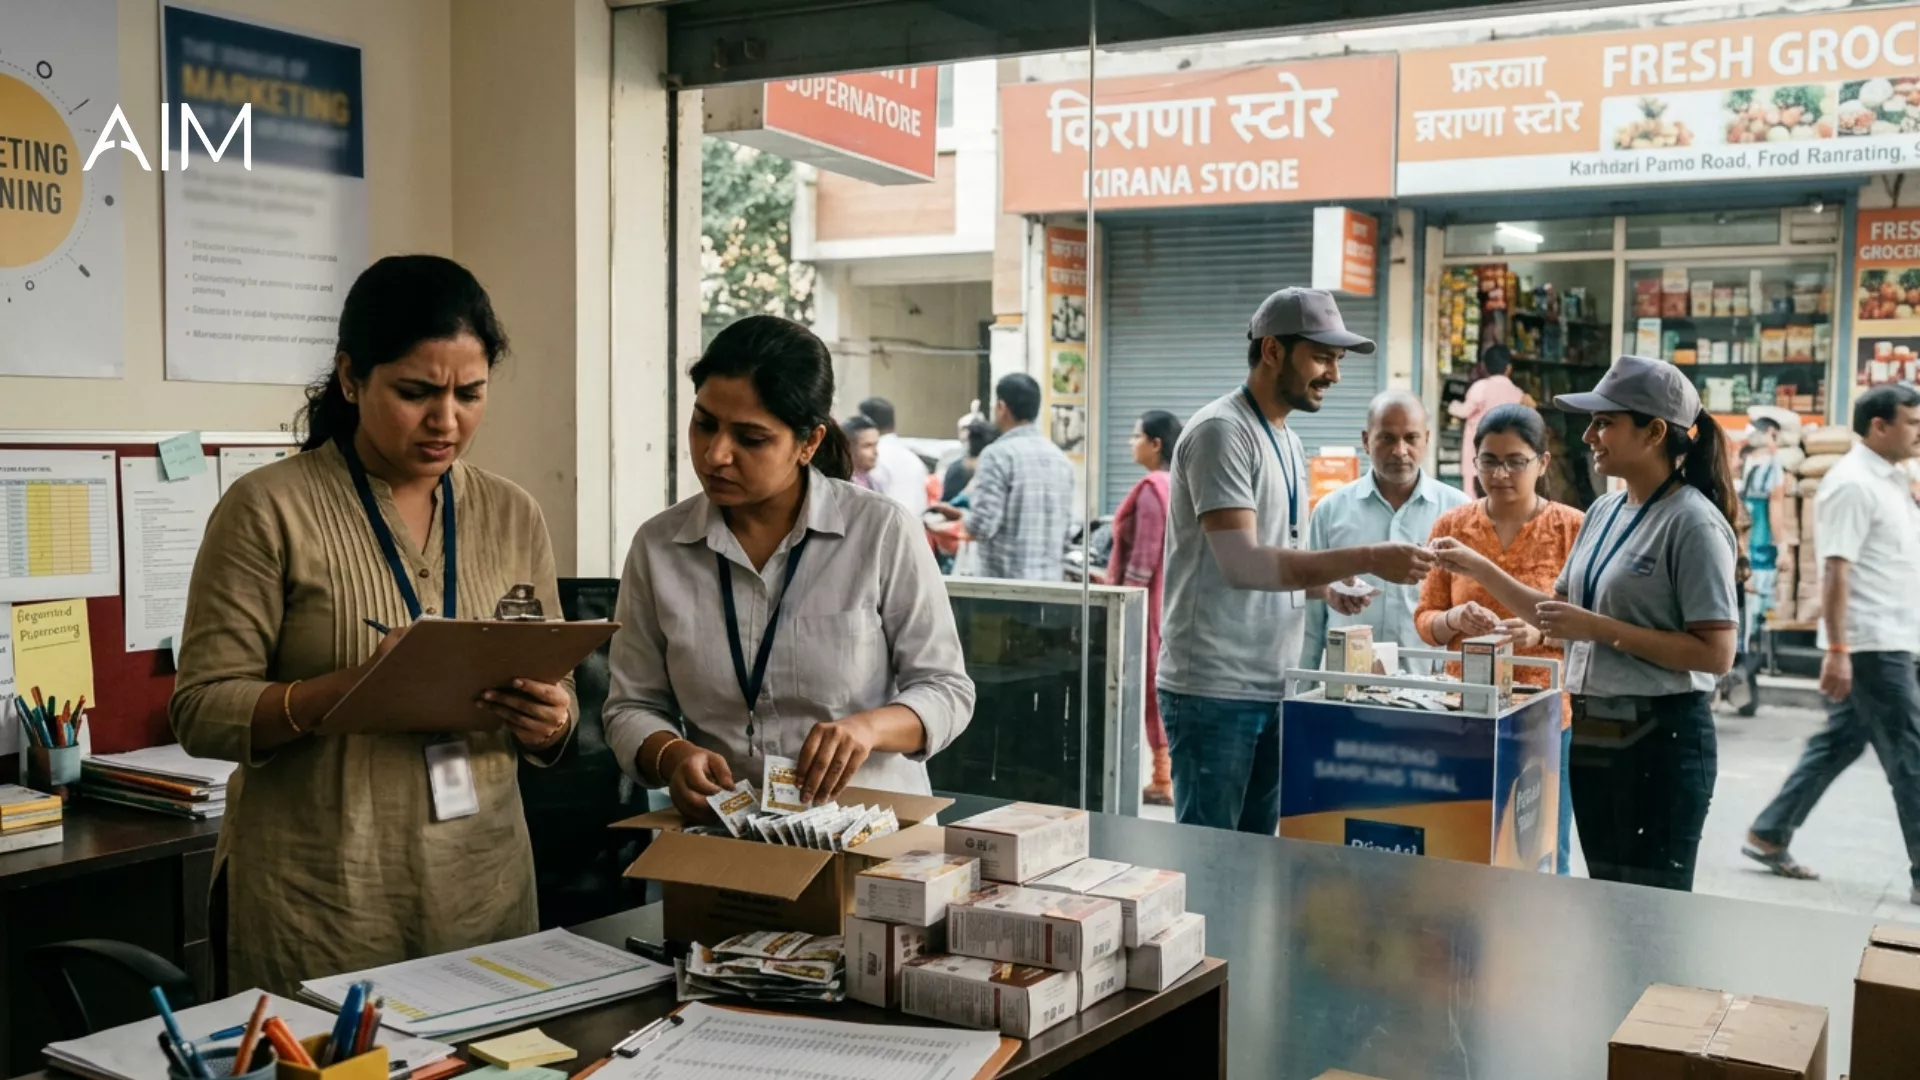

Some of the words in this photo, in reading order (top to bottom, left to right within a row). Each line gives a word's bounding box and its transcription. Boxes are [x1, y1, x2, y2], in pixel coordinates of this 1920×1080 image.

[1603, 36, 1753, 88] FRESH
[1768, 20, 1920, 75] GROC
[181, 64, 350, 126] MARKETING
[1046, 89, 1217, 153] किराणा
[1226, 72, 1340, 144] स्टोर
[1512, 90, 1584, 135] स्टोर
[1083, 164, 1193, 200] KIRANA
[1200, 158, 1299, 193] STORE
[1701, 151, 1751, 170] Road,
[1410, 769, 1460, 793] TRIAL
